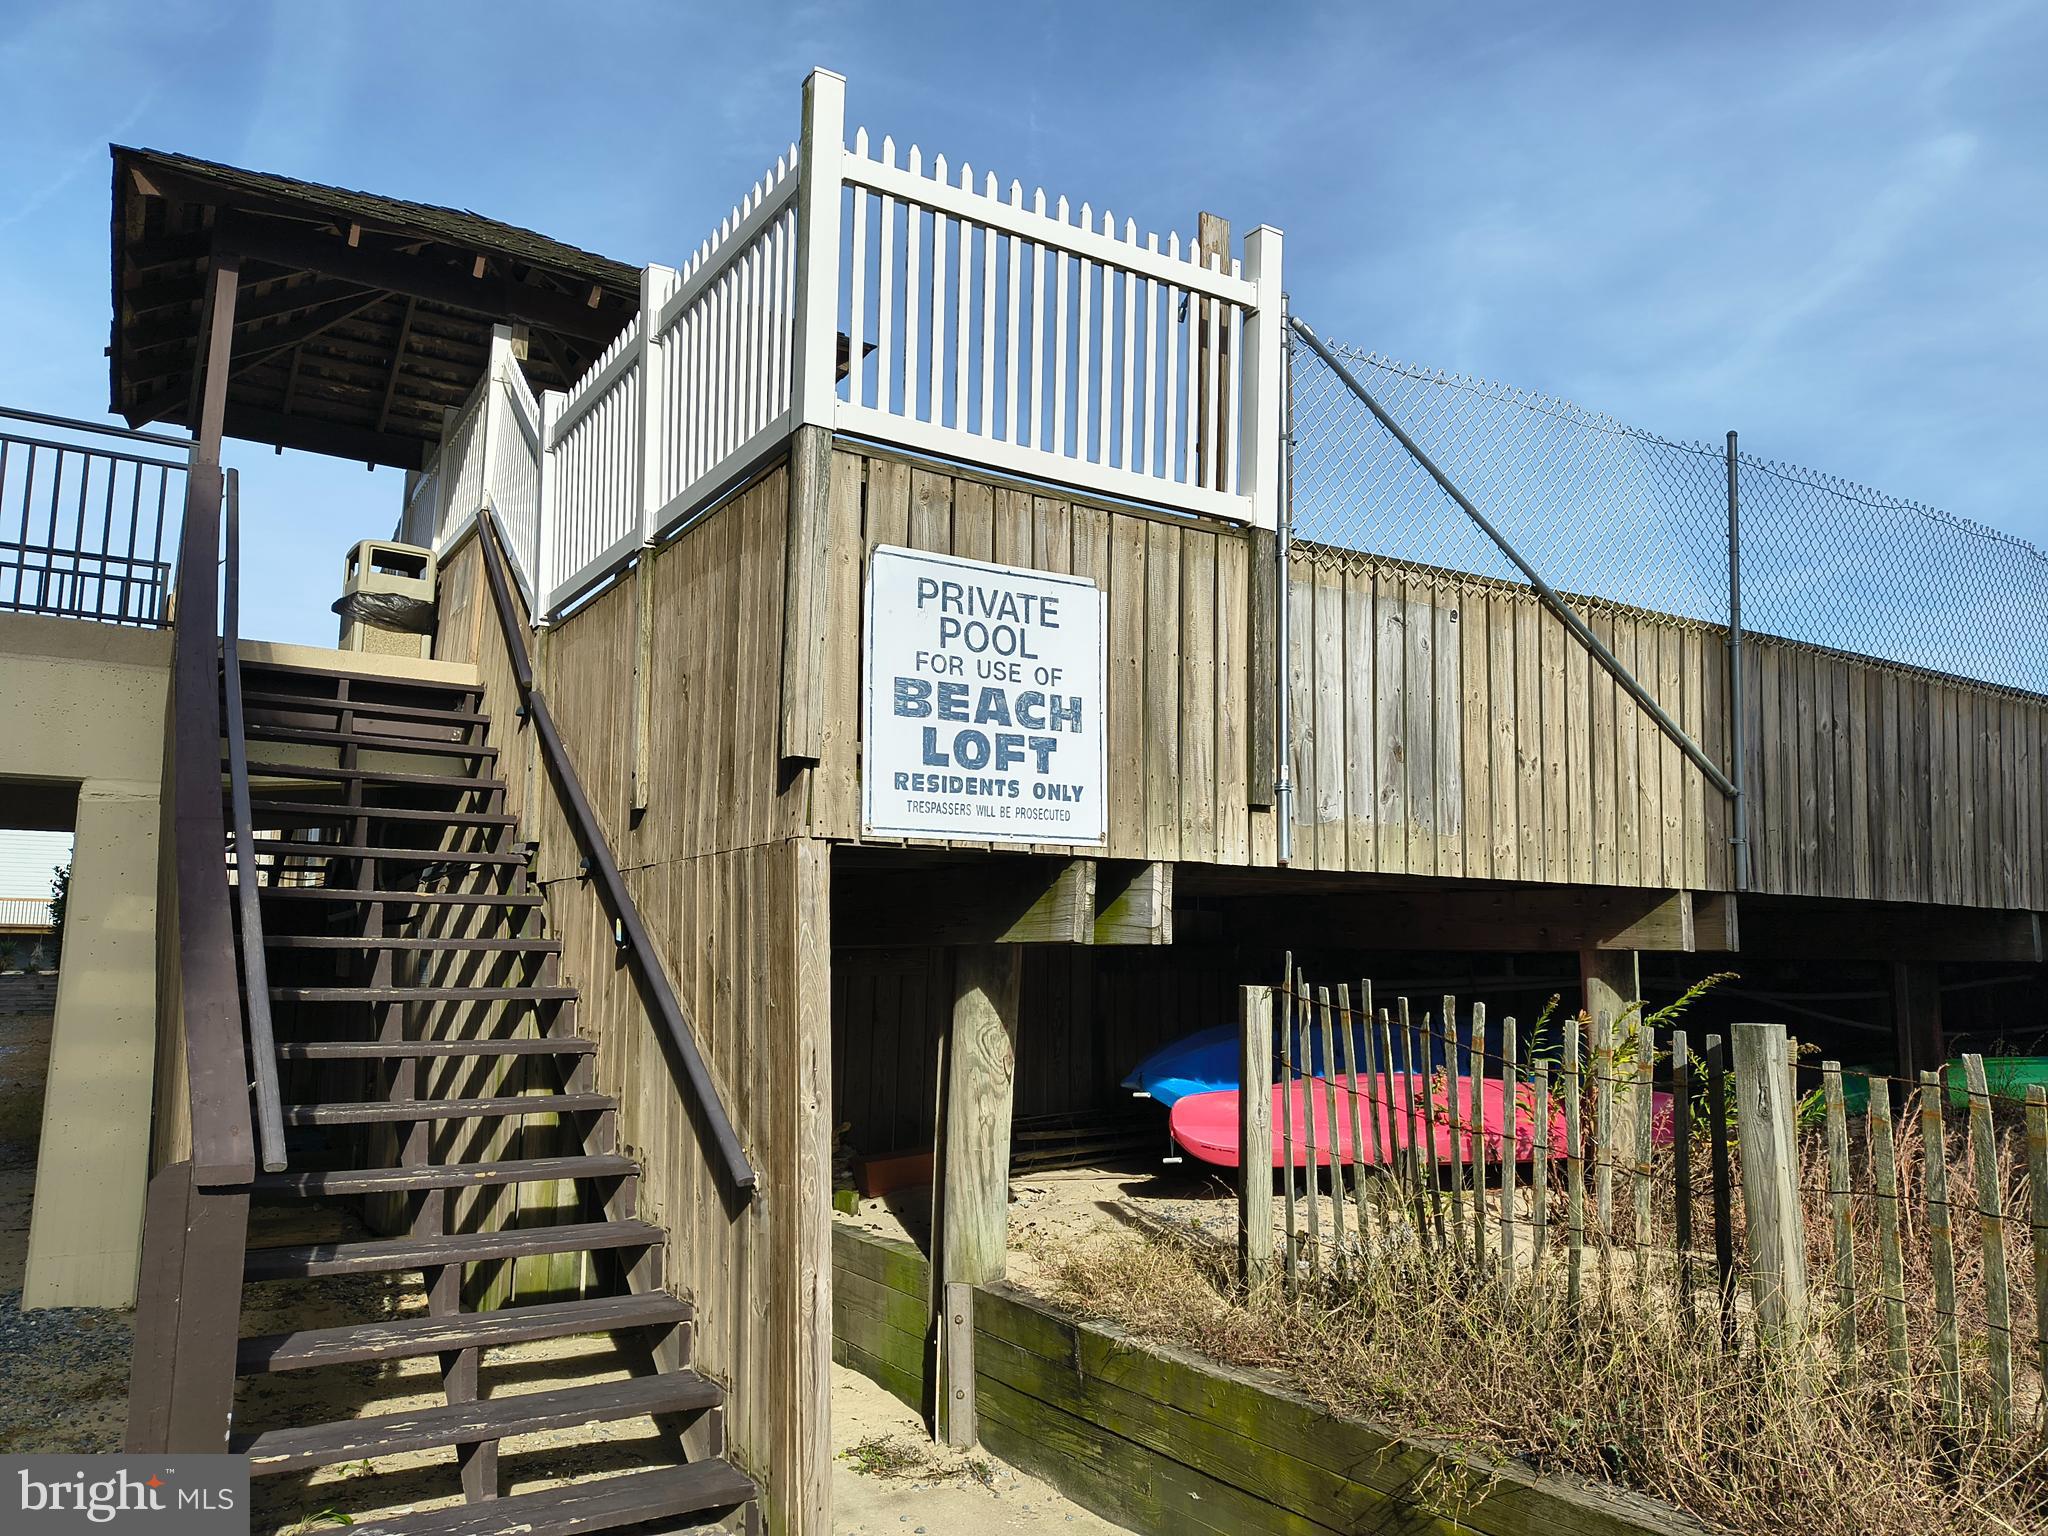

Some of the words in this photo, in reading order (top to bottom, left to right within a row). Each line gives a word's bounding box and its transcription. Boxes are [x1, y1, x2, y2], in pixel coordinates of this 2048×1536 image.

[917, 576, 1060, 628] PRIVATE
[940, 616, 1038, 660] POOL
[916, 650, 964, 676] FOR
[977, 659, 1022, 683] USE
[1034, 666, 1063, 687] OF
[893, 676, 1083, 733] BEACH
[922, 726, 1057, 774] LOFT
[894, 772, 1020, 798] RESIDENTS
[1033, 782, 1084, 802] ONLY
[907, 800, 972, 816] TRESPASSERS
[976, 804, 996, 818] WILL
[1000, 806, 1011, 819] BE
[1015, 807, 1071, 822] PROSECUTED
